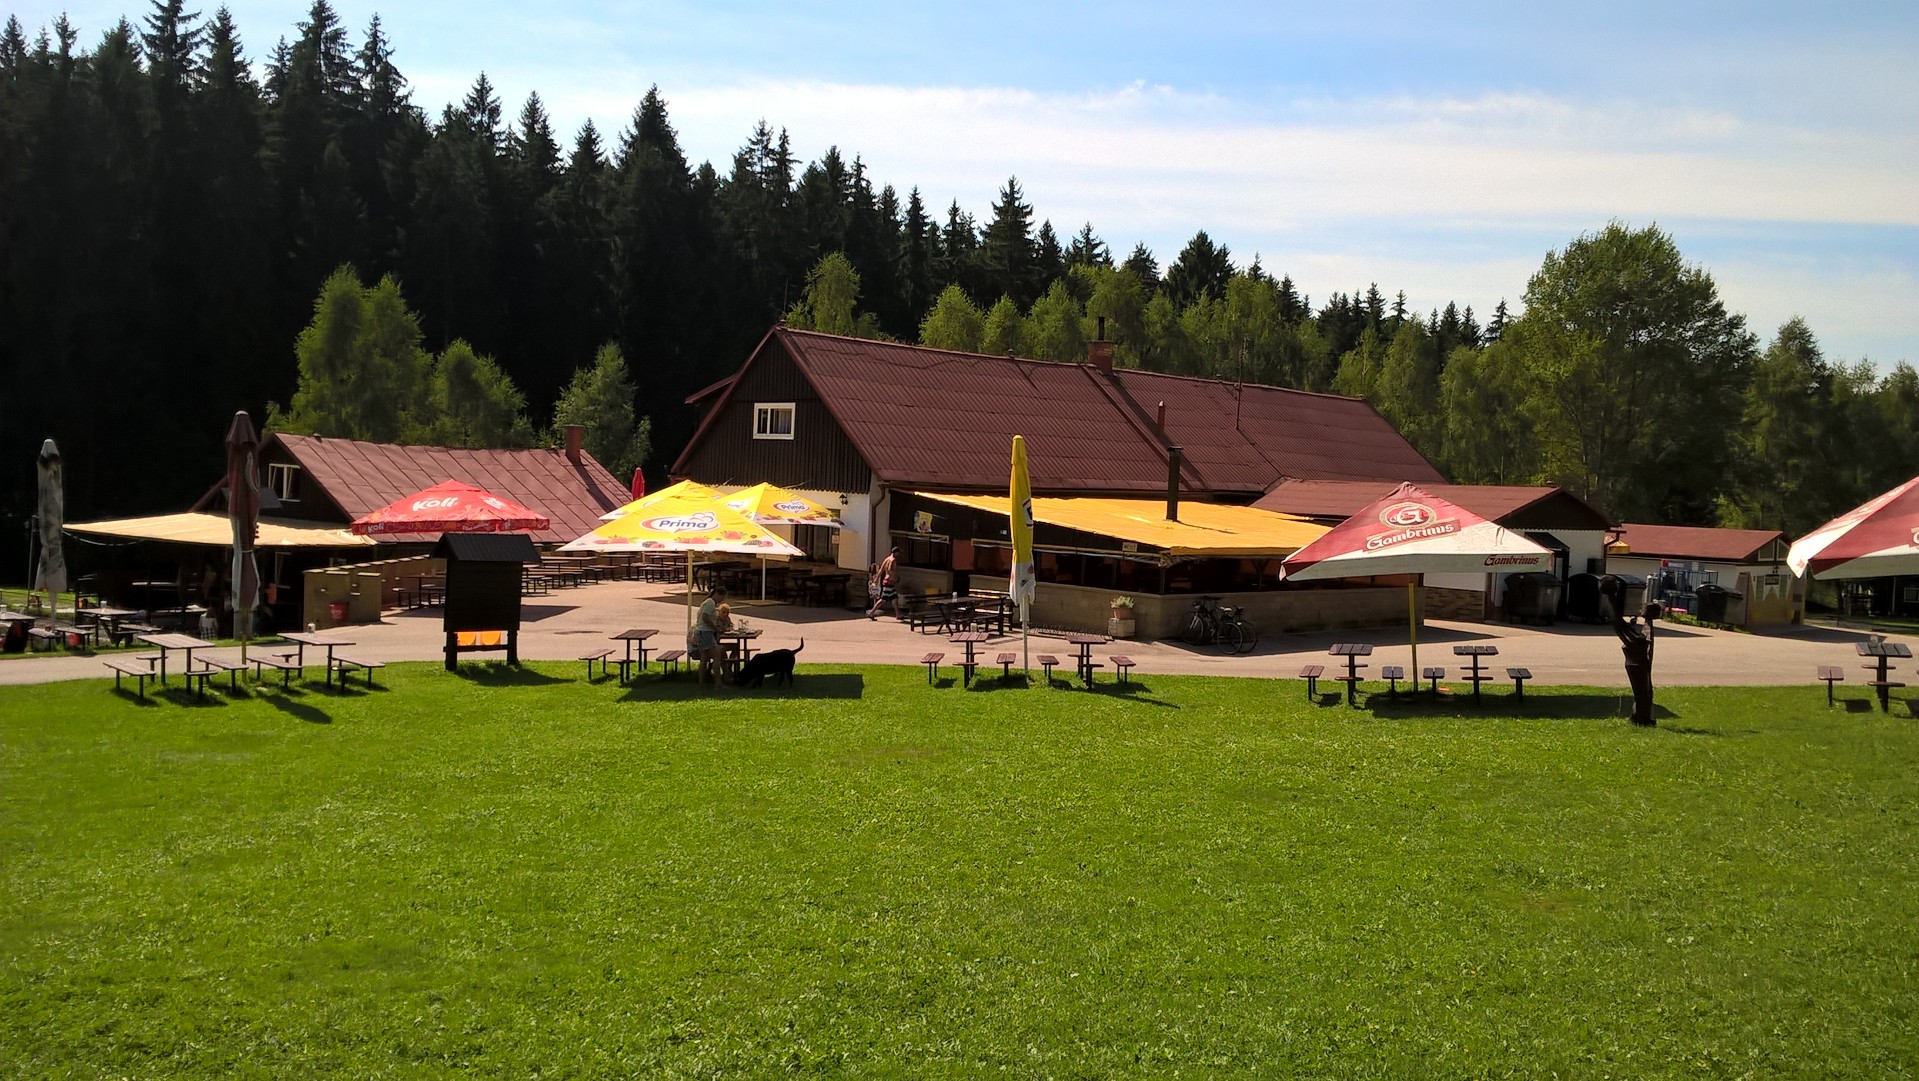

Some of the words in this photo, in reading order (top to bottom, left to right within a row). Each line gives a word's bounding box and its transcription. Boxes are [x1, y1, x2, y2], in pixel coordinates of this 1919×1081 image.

[659, 520, 708, 529] Prima
[1366, 524, 1454, 550] Gambrinus
[1484, 554, 1540, 567] Gambrinus
